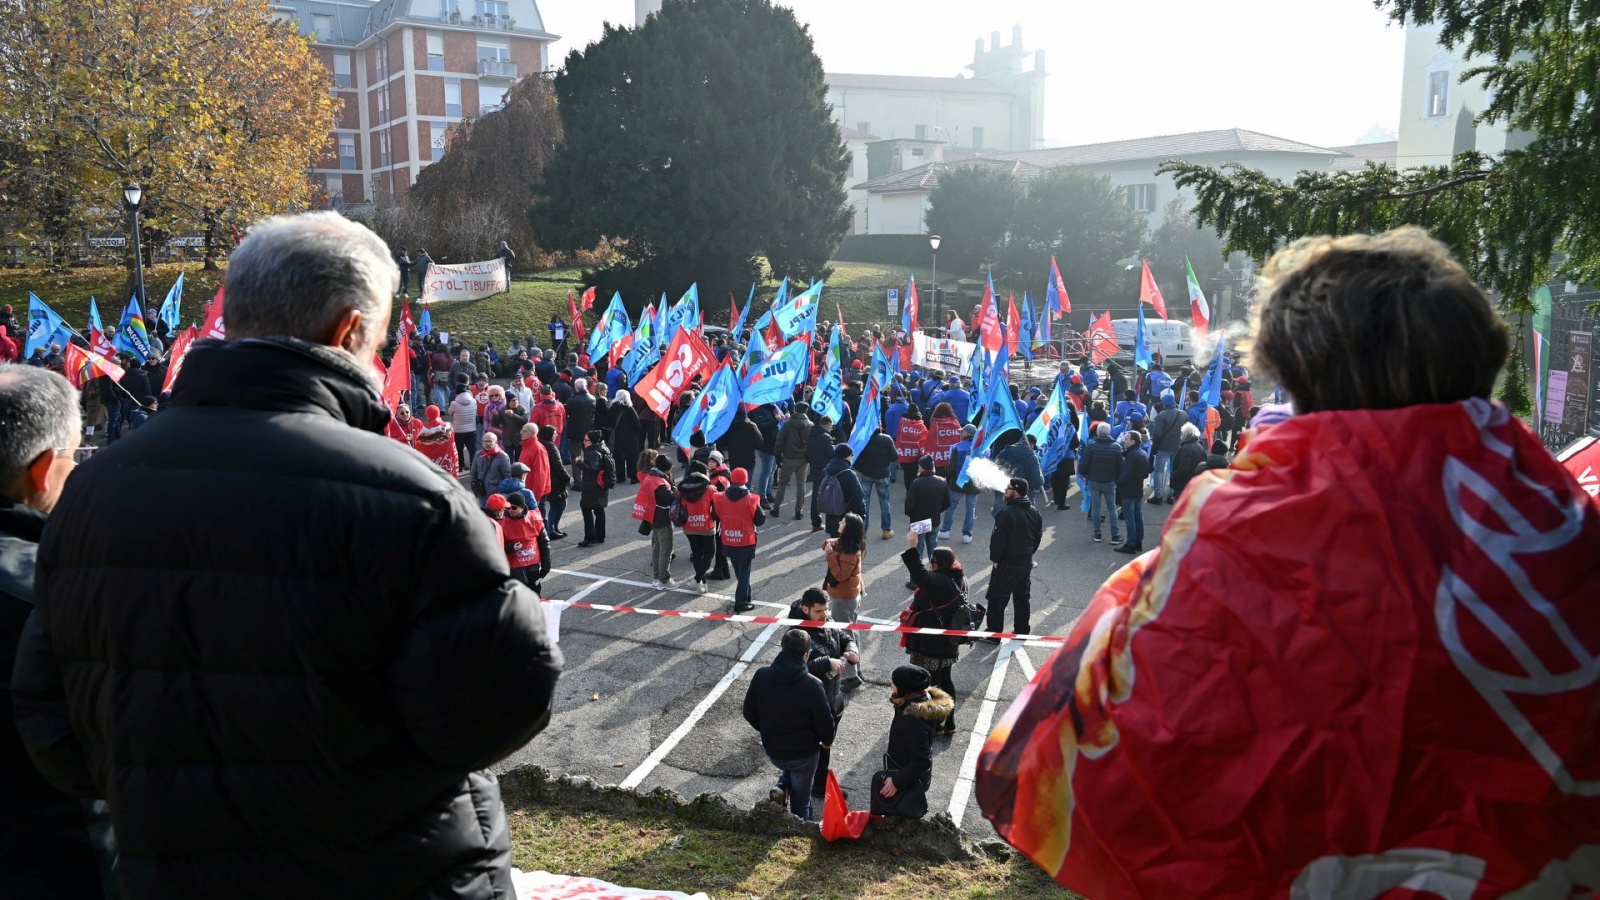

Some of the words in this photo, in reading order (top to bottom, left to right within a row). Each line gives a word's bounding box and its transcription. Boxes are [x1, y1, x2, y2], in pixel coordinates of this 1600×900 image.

[902, 426, 922, 435] CGIL
[938, 428, 961, 437] CGIL
[688, 514, 707, 522] CGIL
[725, 529, 743, 537] CGIL
